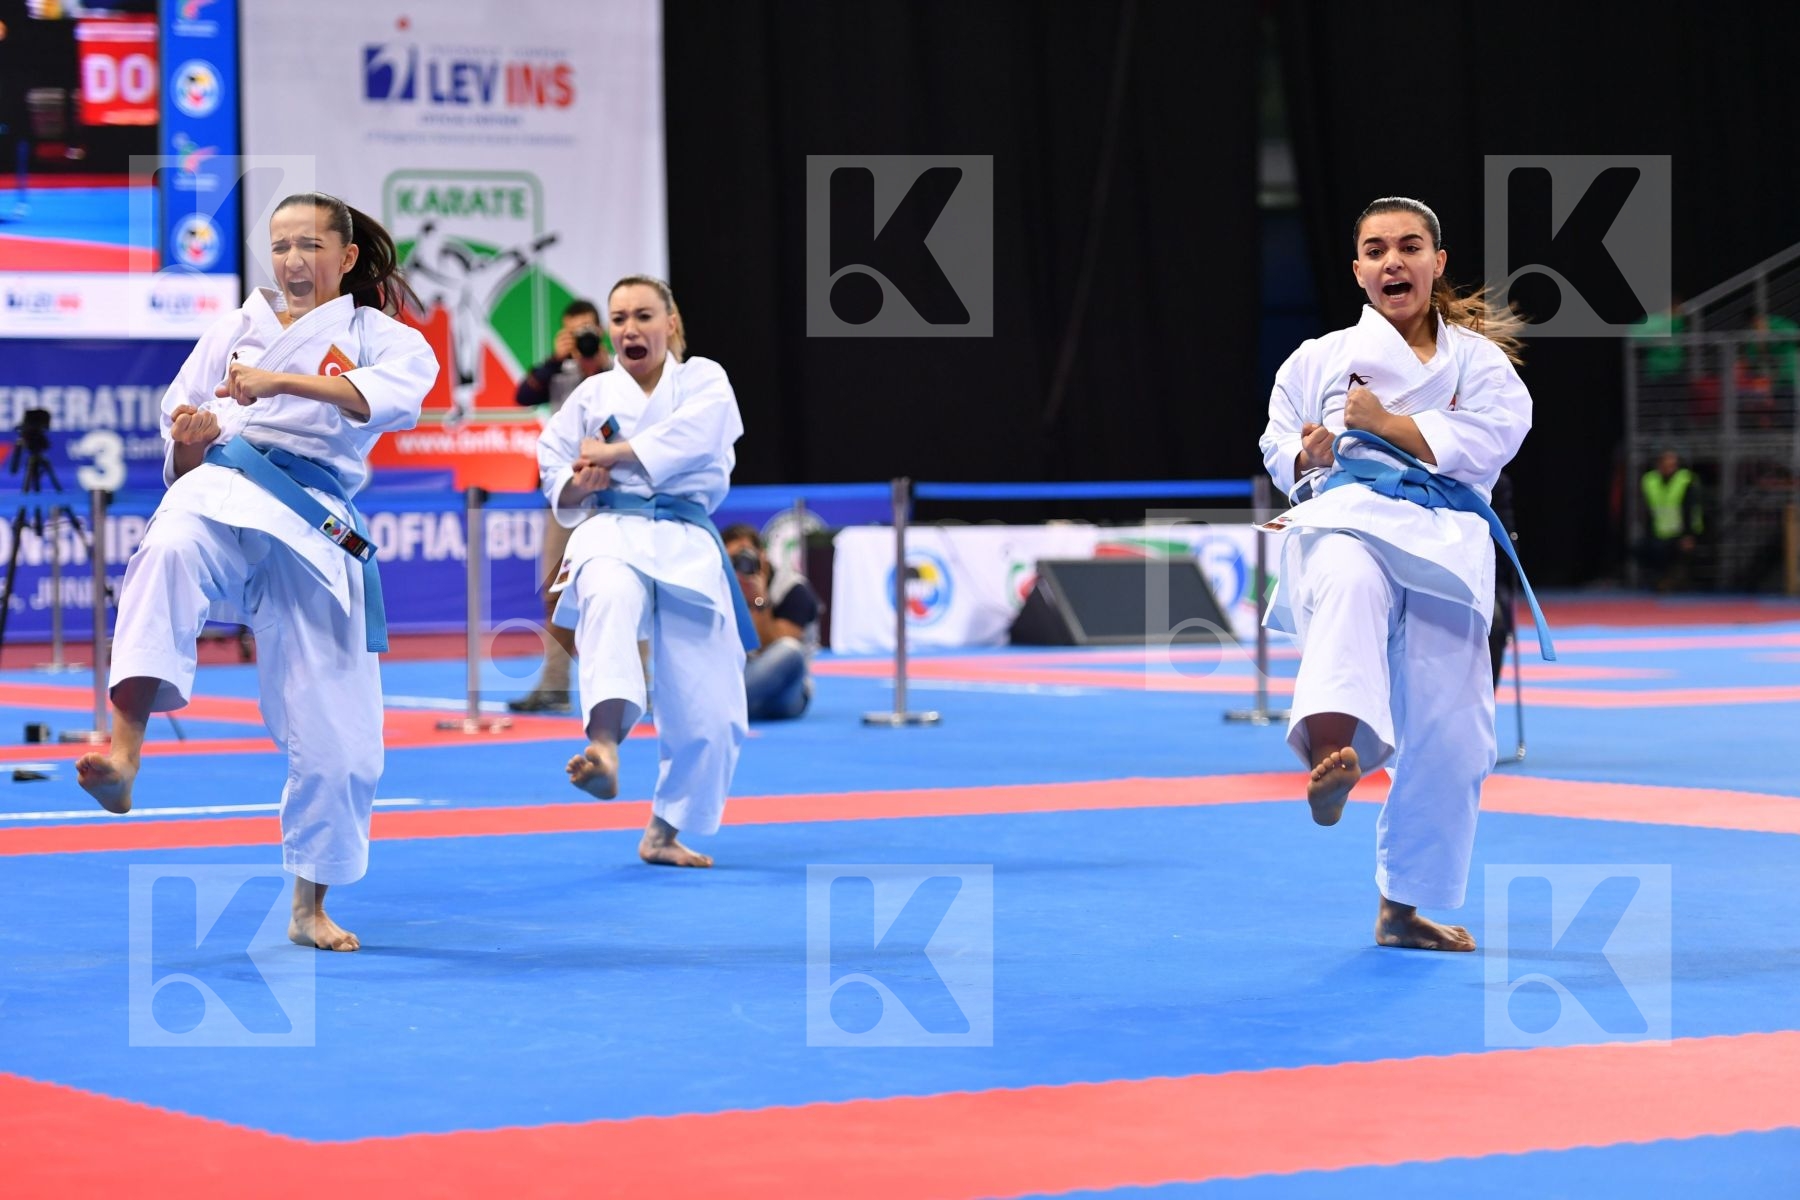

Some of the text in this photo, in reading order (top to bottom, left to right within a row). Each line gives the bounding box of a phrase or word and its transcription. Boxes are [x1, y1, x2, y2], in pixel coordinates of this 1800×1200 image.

[82, 53, 156, 104] DO
[428, 60, 575, 112] LEV INS
[396, 185, 527, 220] KARATE
[78, 429, 126, 491] 3
[363, 510, 469, 564] OFIA,
